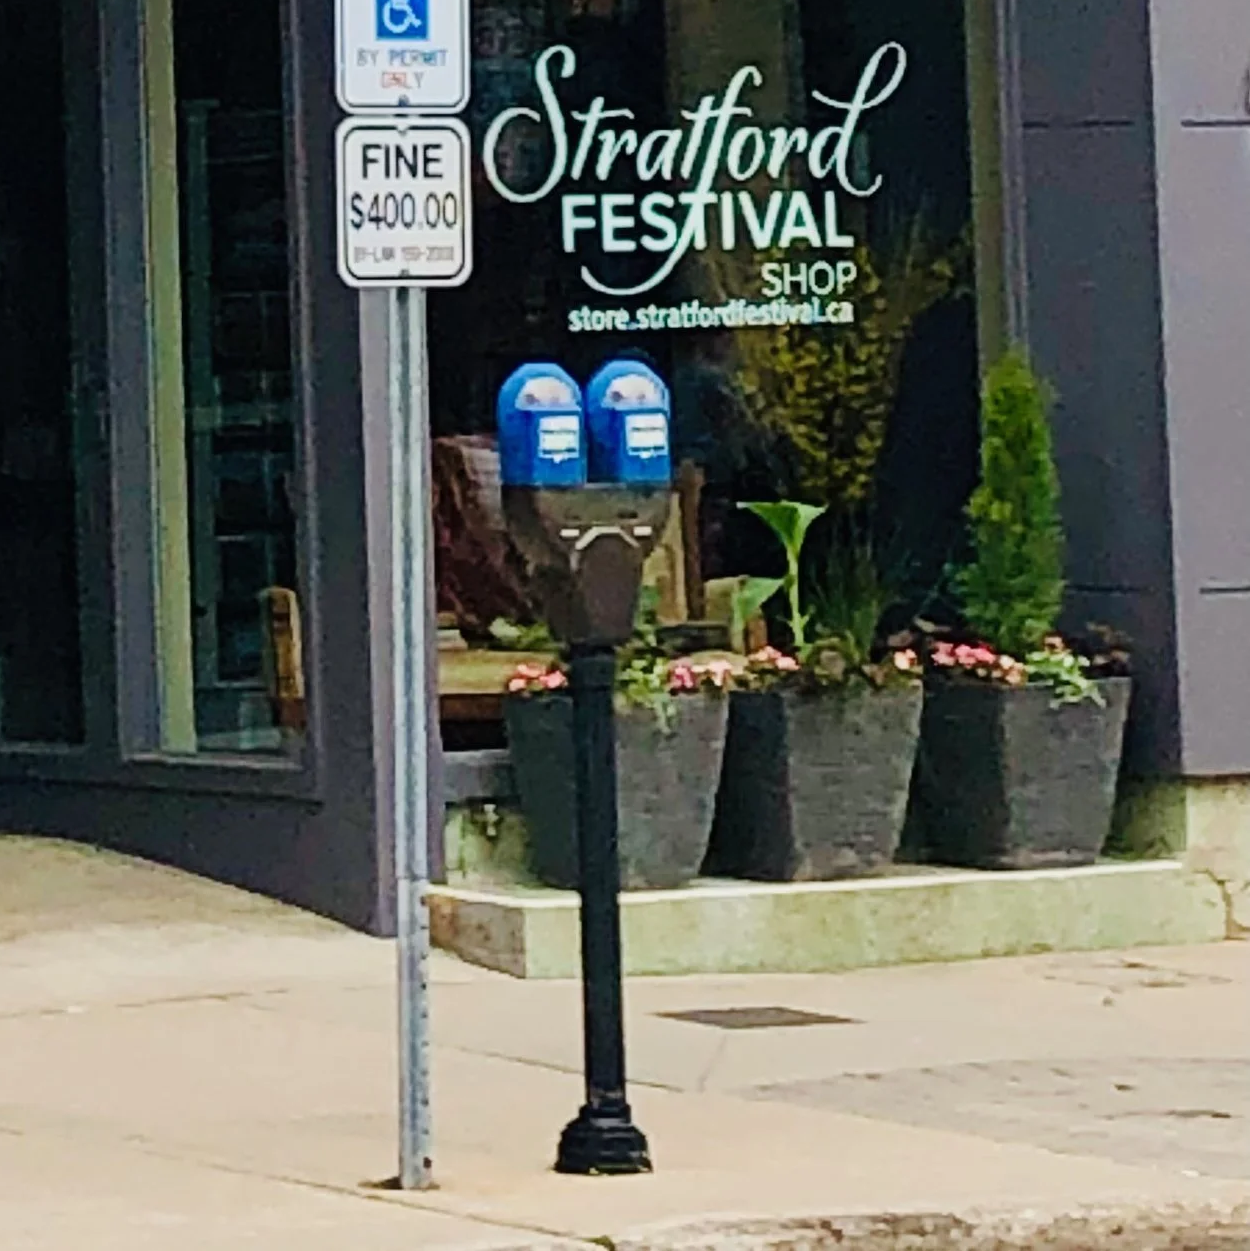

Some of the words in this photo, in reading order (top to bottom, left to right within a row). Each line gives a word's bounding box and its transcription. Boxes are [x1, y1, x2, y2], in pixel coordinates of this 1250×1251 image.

[362, 143, 443, 179] FINE
[483, 41, 907, 296] Stratford
[350, 191, 458, 231] $400.00
[561, 190, 855, 253] FESTIVAL
[760, 260, 857, 300] SHOP
[568, 296, 854, 332] store.stratfordfestival.ca
